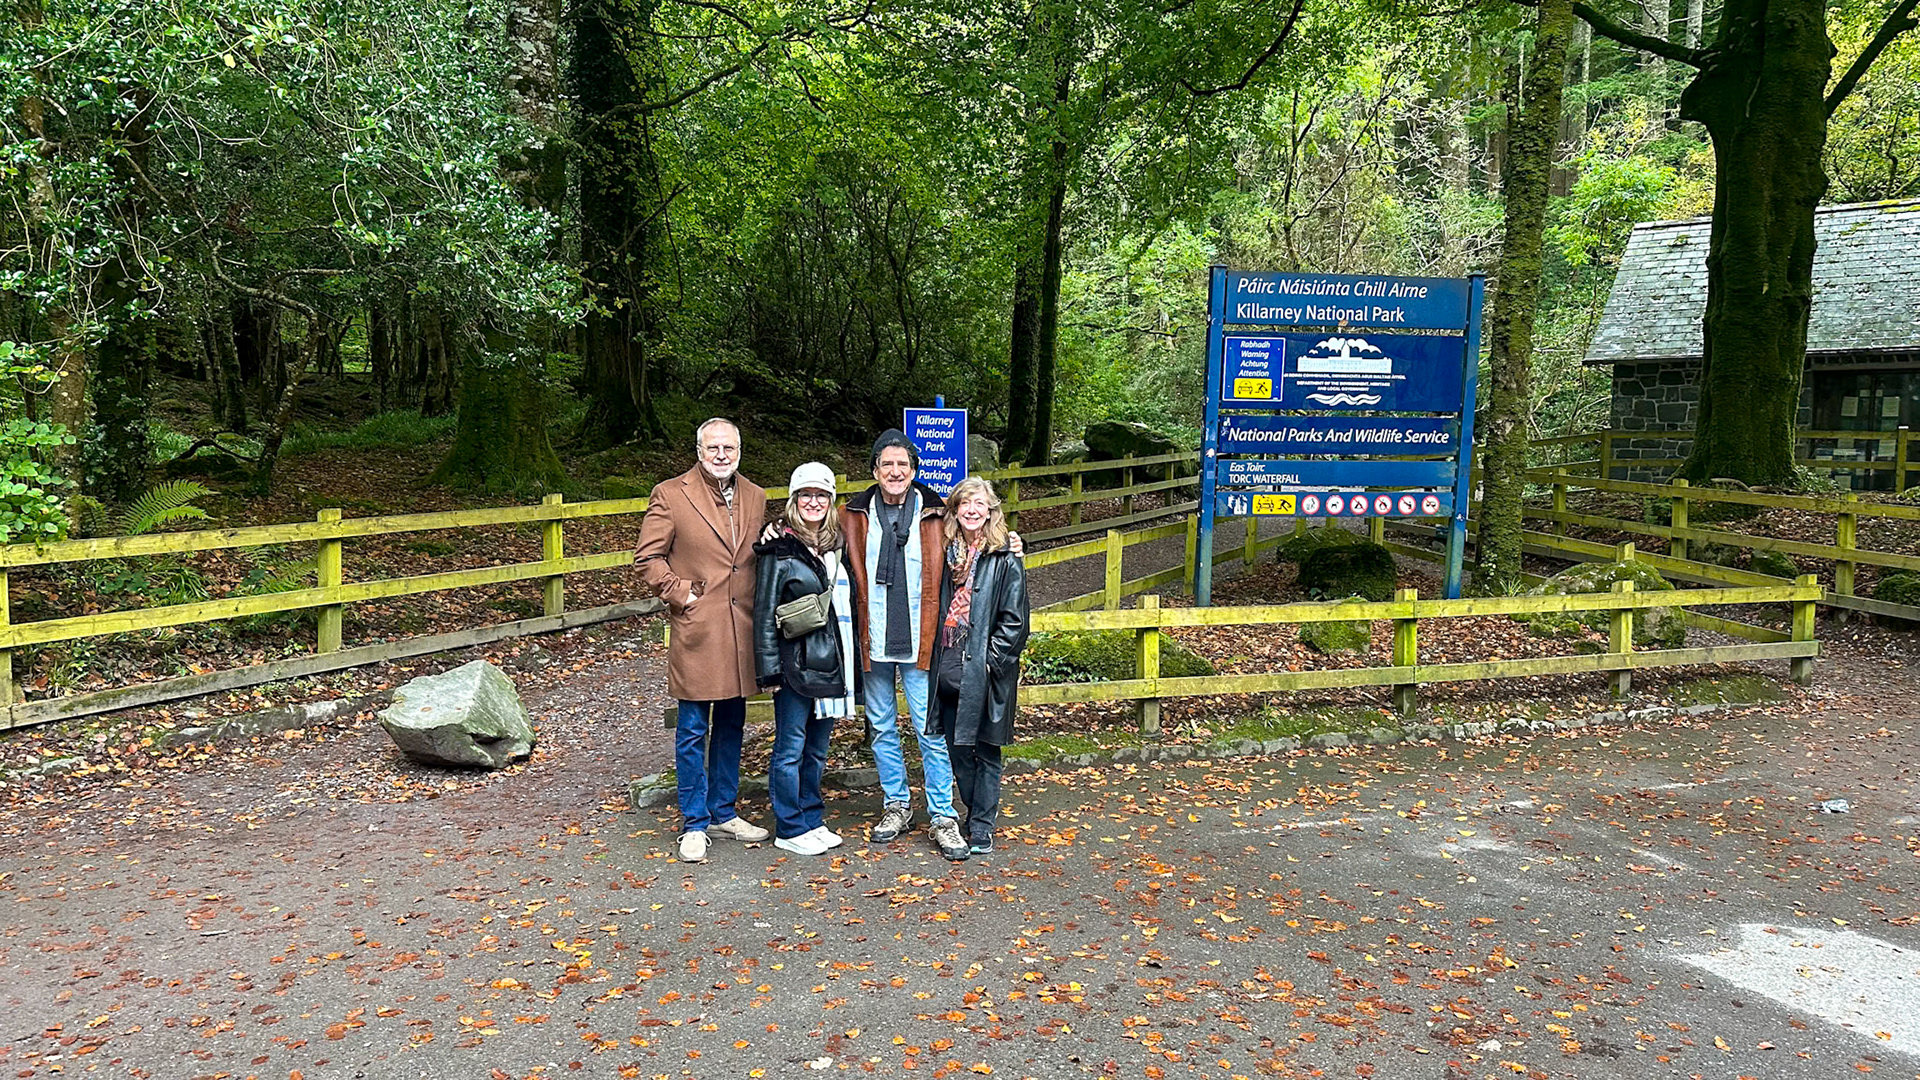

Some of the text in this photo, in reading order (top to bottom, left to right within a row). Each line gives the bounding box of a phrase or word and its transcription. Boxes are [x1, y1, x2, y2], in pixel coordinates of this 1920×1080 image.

[1237, 277, 1427, 299] Páirc Náisiúnta Chill Airne
[1236, 303, 1405, 323] Killarney National Park
[1240, 340, 1271, 348] Rabhadh
[1241, 350, 1269, 359] Warning
[1240, 360, 1269, 369] Achtung
[1238, 369, 1269, 377] Attention
[916, 415, 955, 428] Killarney
[916, 428, 955, 438] National
[1228, 426, 1450, 444] National Parks And Wildlife Service
[925, 442, 945, 452] Park
[1230, 462, 1266, 472] Eas Toirc
[919, 470, 952, 482] Parking
[1229, 474, 1301, 484] TORC WATERFALL
